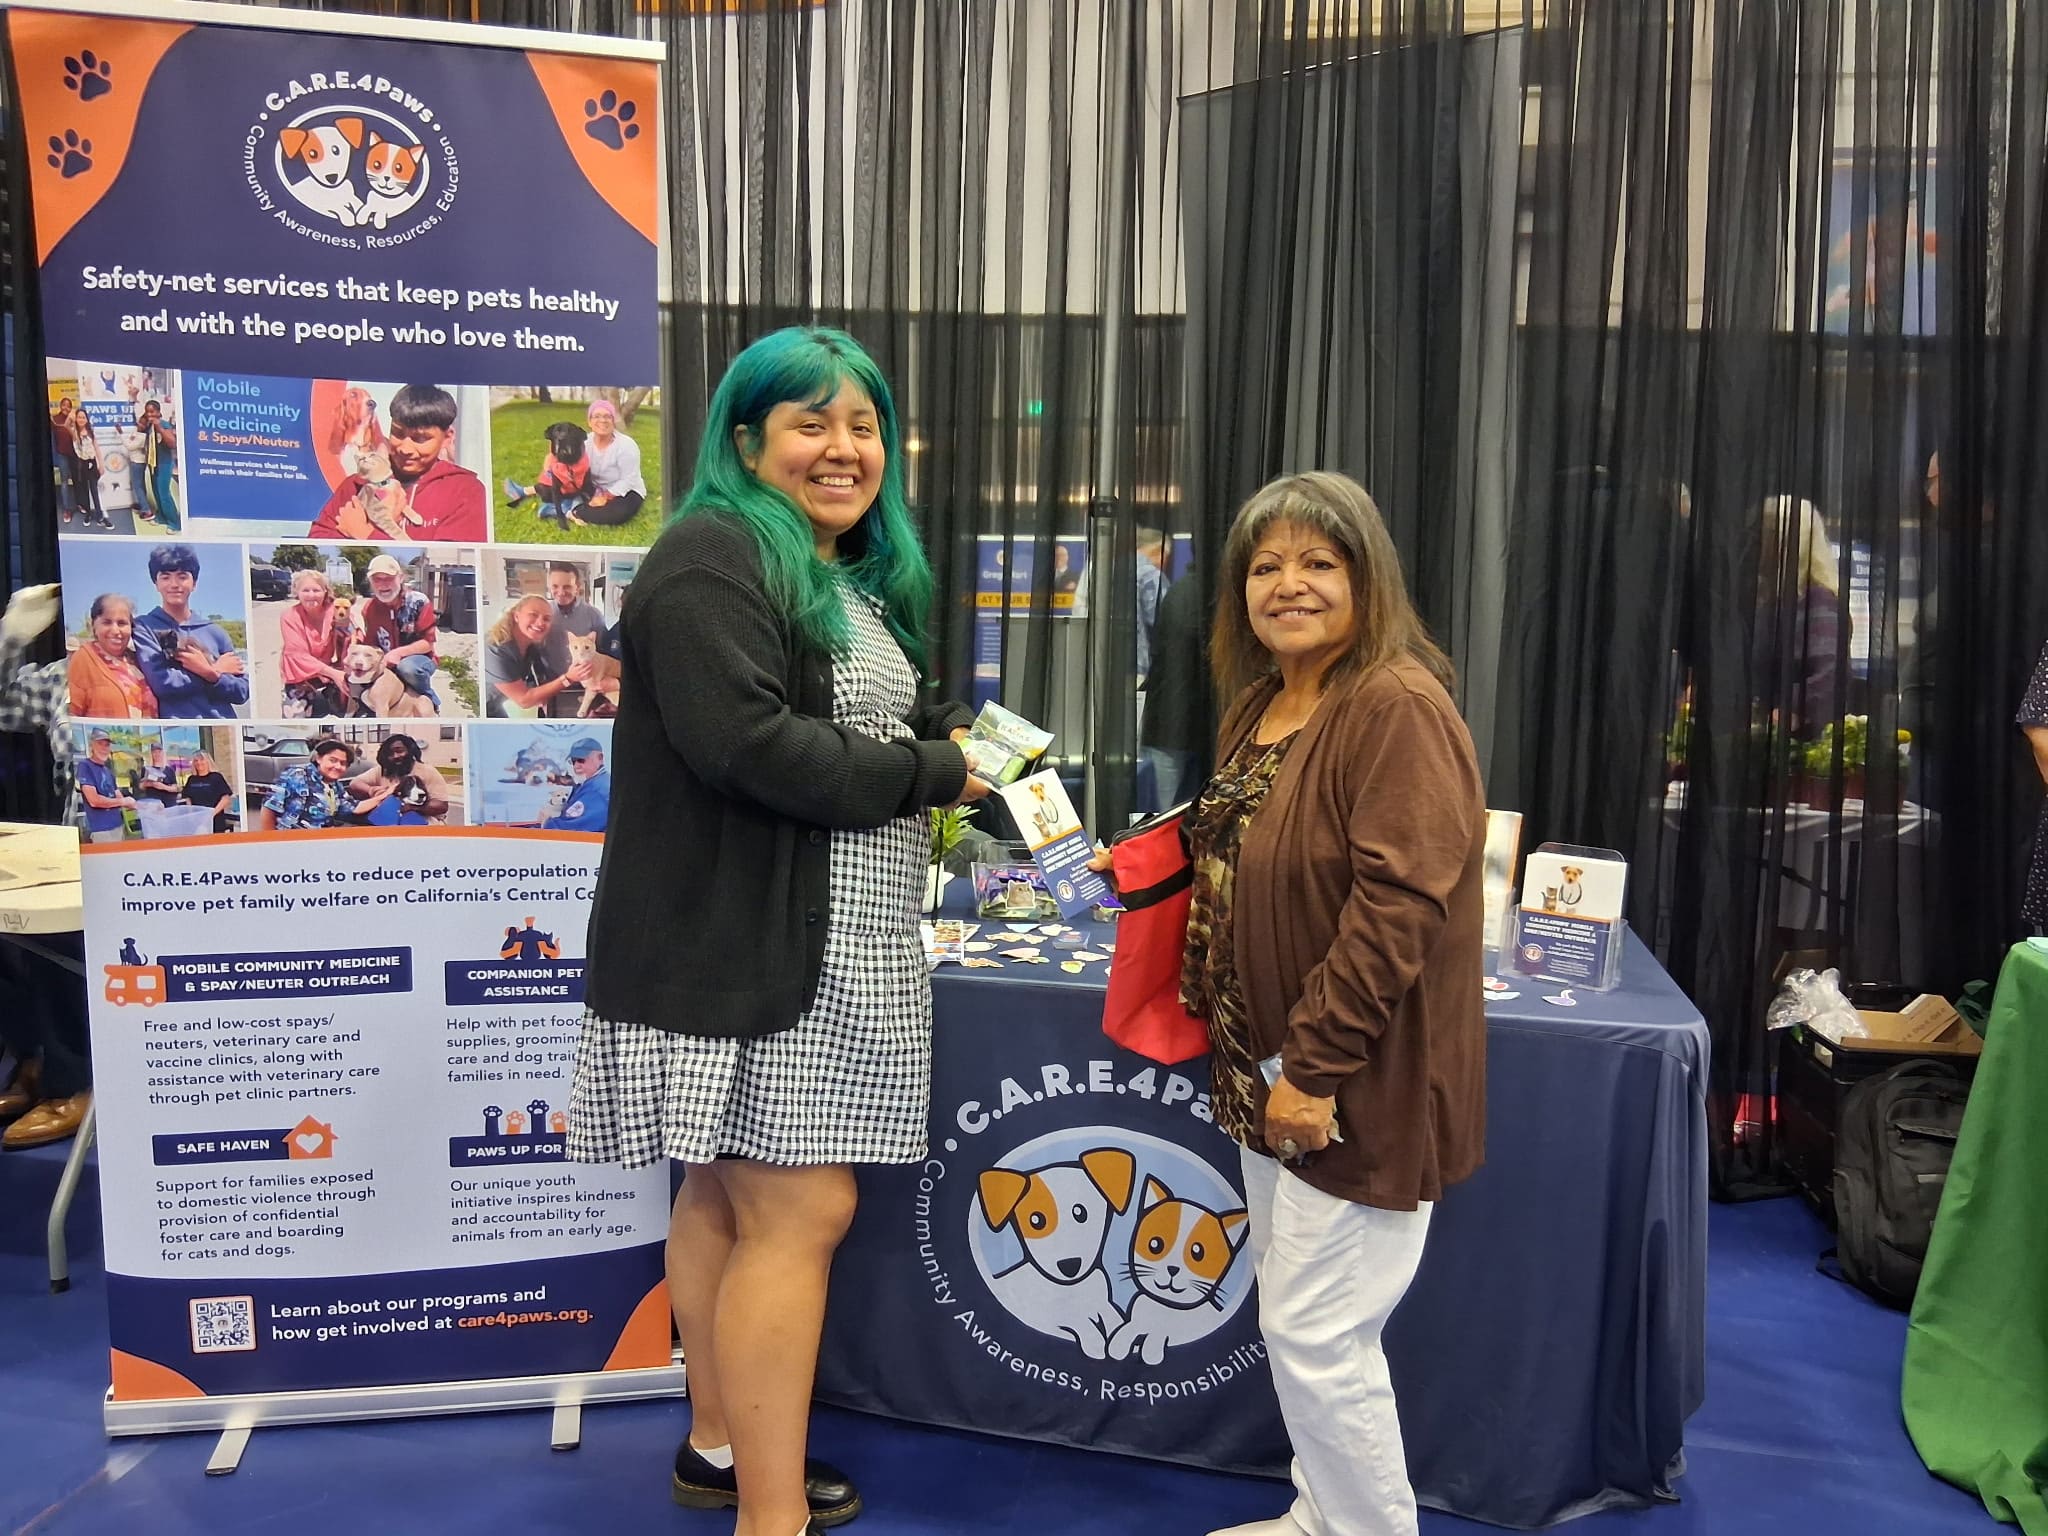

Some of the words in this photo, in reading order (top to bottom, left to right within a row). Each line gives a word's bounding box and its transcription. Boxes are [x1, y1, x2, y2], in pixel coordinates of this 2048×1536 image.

[266, 71, 433, 123] C.A.R.E.4Paws
[244, 125, 275, 211] Community
[274, 210, 361, 250] Awareness,
[366, 216, 442, 249] Resources,
[436, 136, 459, 212] Education
[82, 265, 216, 296] Safety-net
[224, 274, 329, 298] services
[336, 277, 390, 302] that
[397, 280, 459, 310] keep
[467, 288, 522, 311] pets
[529, 287, 619, 320] healthy
[120, 309, 168, 332] and
[176, 311, 234, 334] with
[242, 313, 286, 336] the
[295, 318, 384, 346] people
[392, 321, 446, 345] who
[453, 323, 506, 347] love
[513, 327, 584, 351] them.
[197, 377, 261, 396] Mobile
[197, 395, 301, 421] Community
[199, 413, 281, 433] Medicine
[198, 430, 208, 441] &
[212, 431, 300, 448] Spays/Neuters
[264, 461, 279, 469] that
[123, 871, 259, 887] C.A.R.E.4Paws
[265, 869, 320, 883] works
[327, 870, 346, 882] to
[352, 866, 414, 881] reduce
[420, 866, 450, 882] pet
[456, 864, 588, 881] overpopulation
[122, 897, 196, 915] improve
[203, 897, 234, 913] pet
[240, 894, 295, 911] family
[302, 892, 369, 907] welfare
[376, 893, 398, 904] on
[507, 887, 569, 901] Central
[173, 963, 229, 975] MOBILE
[234, 960, 324, 973] COMMUNITY
[330, 956, 400, 969] MEDICINE
[467, 969, 552, 980] COMPANION
[558, 969, 583, 978] PET
[185, 982, 195, 992] &
[201, 978, 303, 992] SPAY/NEUTER
[309, 974, 390, 987] OUTREACH
[484, 986, 569, 996] ASSISTANCE
[144, 1021, 177, 1032] Free
[183, 1018, 212, 1031] and
[217, 1017, 282, 1030] low-cost
[286, 1013, 335, 1029] spays/
[447, 1018, 481, 1032] Help
[486, 1016, 516, 1029] with
[522, 1017, 546, 1031] pet
[145, 1039, 208, 1050] neuters,
[213, 1035, 290, 1048] veterinary
[295, 1033, 327, 1044] care
[332, 1030, 361, 1043] and
[447, 1035, 510, 1049] supplies,
[147, 1056, 202, 1068] vaccine
[208, 1054, 258, 1066] clinics,
[263, 1052, 305, 1065] along
[310, 1049, 343, 1061] with
[448, 1054, 477, 1065] care
[483, 1052, 509, 1063] and
[515, 1051, 543, 1064] dog
[148, 1074, 224, 1086] assistance
[230, 1070, 262, 1083] with
[267, 1068, 344, 1081] veterinary
[349, 1066, 380, 1077] care
[448, 1069, 503, 1082] families
[508, 1069, 520, 1079] in
[526, 1067, 565, 1079] need.
[149, 1091, 210, 1105] through
[216, 1089, 241, 1104] pet
[246, 1088, 284, 1100] clinic
[288, 1085, 356, 1101] partners.
[956, 1060, 1215, 1134] C.A.R.E.4Pa
[177, 1143, 215, 1154] SAFE
[220, 1139, 270, 1151] HAVEN
[467, 1146, 506, 1157] PAWS
[511, 1146, 530, 1155] UP
[535, 1144, 562, 1153] FOR
[156, 1178, 217, 1194] Support
[223, 1177, 244, 1189] for
[249, 1174, 305, 1187] families
[310, 1169, 374, 1187] exposed
[450, 1180, 478, 1192] Our
[483, 1178, 531, 1192] unique
[536, 1174, 576, 1189] youth
[157, 1199, 173, 1209] to
[178, 1194, 247, 1208] domestic
[251, 1192, 312, 1204] violence
[317, 1186, 376, 1201] through
[451, 1195, 512, 1209] initiative
[517, 1194, 571, 1207] inspires
[575, 1190, 636, 1202] kindness
[159, 1213, 227, 1229] provision
[232, 1210, 248, 1223] of
[252, 1206, 339, 1221] confidential
[451, 1213, 477, 1226] and
[483, 1209, 581, 1224] accountability
[586, 1207, 605, 1218] for
[160, 1231, 204, 1244] foster
[209, 1230, 240, 1241] care
[245, 1226, 272, 1239] and
[278, 1224, 344, 1238] boarding
[452, 1228, 505, 1243] animals
[509, 1227, 543, 1238] from
[547, 1226, 564, 1236] an
[569, 1224, 602, 1237] early
[607, 1223, 636, 1236] age.
[161, 1249, 183, 1261] for
[188, 1248, 218, 1259] cats
[223, 1245, 249, 1257] and
[255, 1244, 295, 1257] dogs.
[916, 1159, 956, 1305] Community
[954, 1309, 1090, 1396] Awareness,
[1101, 1340, 1266, 1405] Responsibilit
[271, 1303, 321, 1319] Learn
[327, 1299, 380, 1315] about
[386, 1295, 417, 1312] our
[422, 1291, 509, 1310] programs
[513, 1285, 546, 1304] and
[272, 1324, 311, 1341] how
[316, 1322, 347, 1341] get
[352, 1315, 429, 1336] involved
[434, 1316, 453, 1331] at
[457, 1308, 594, 1329] care4paws.org.
